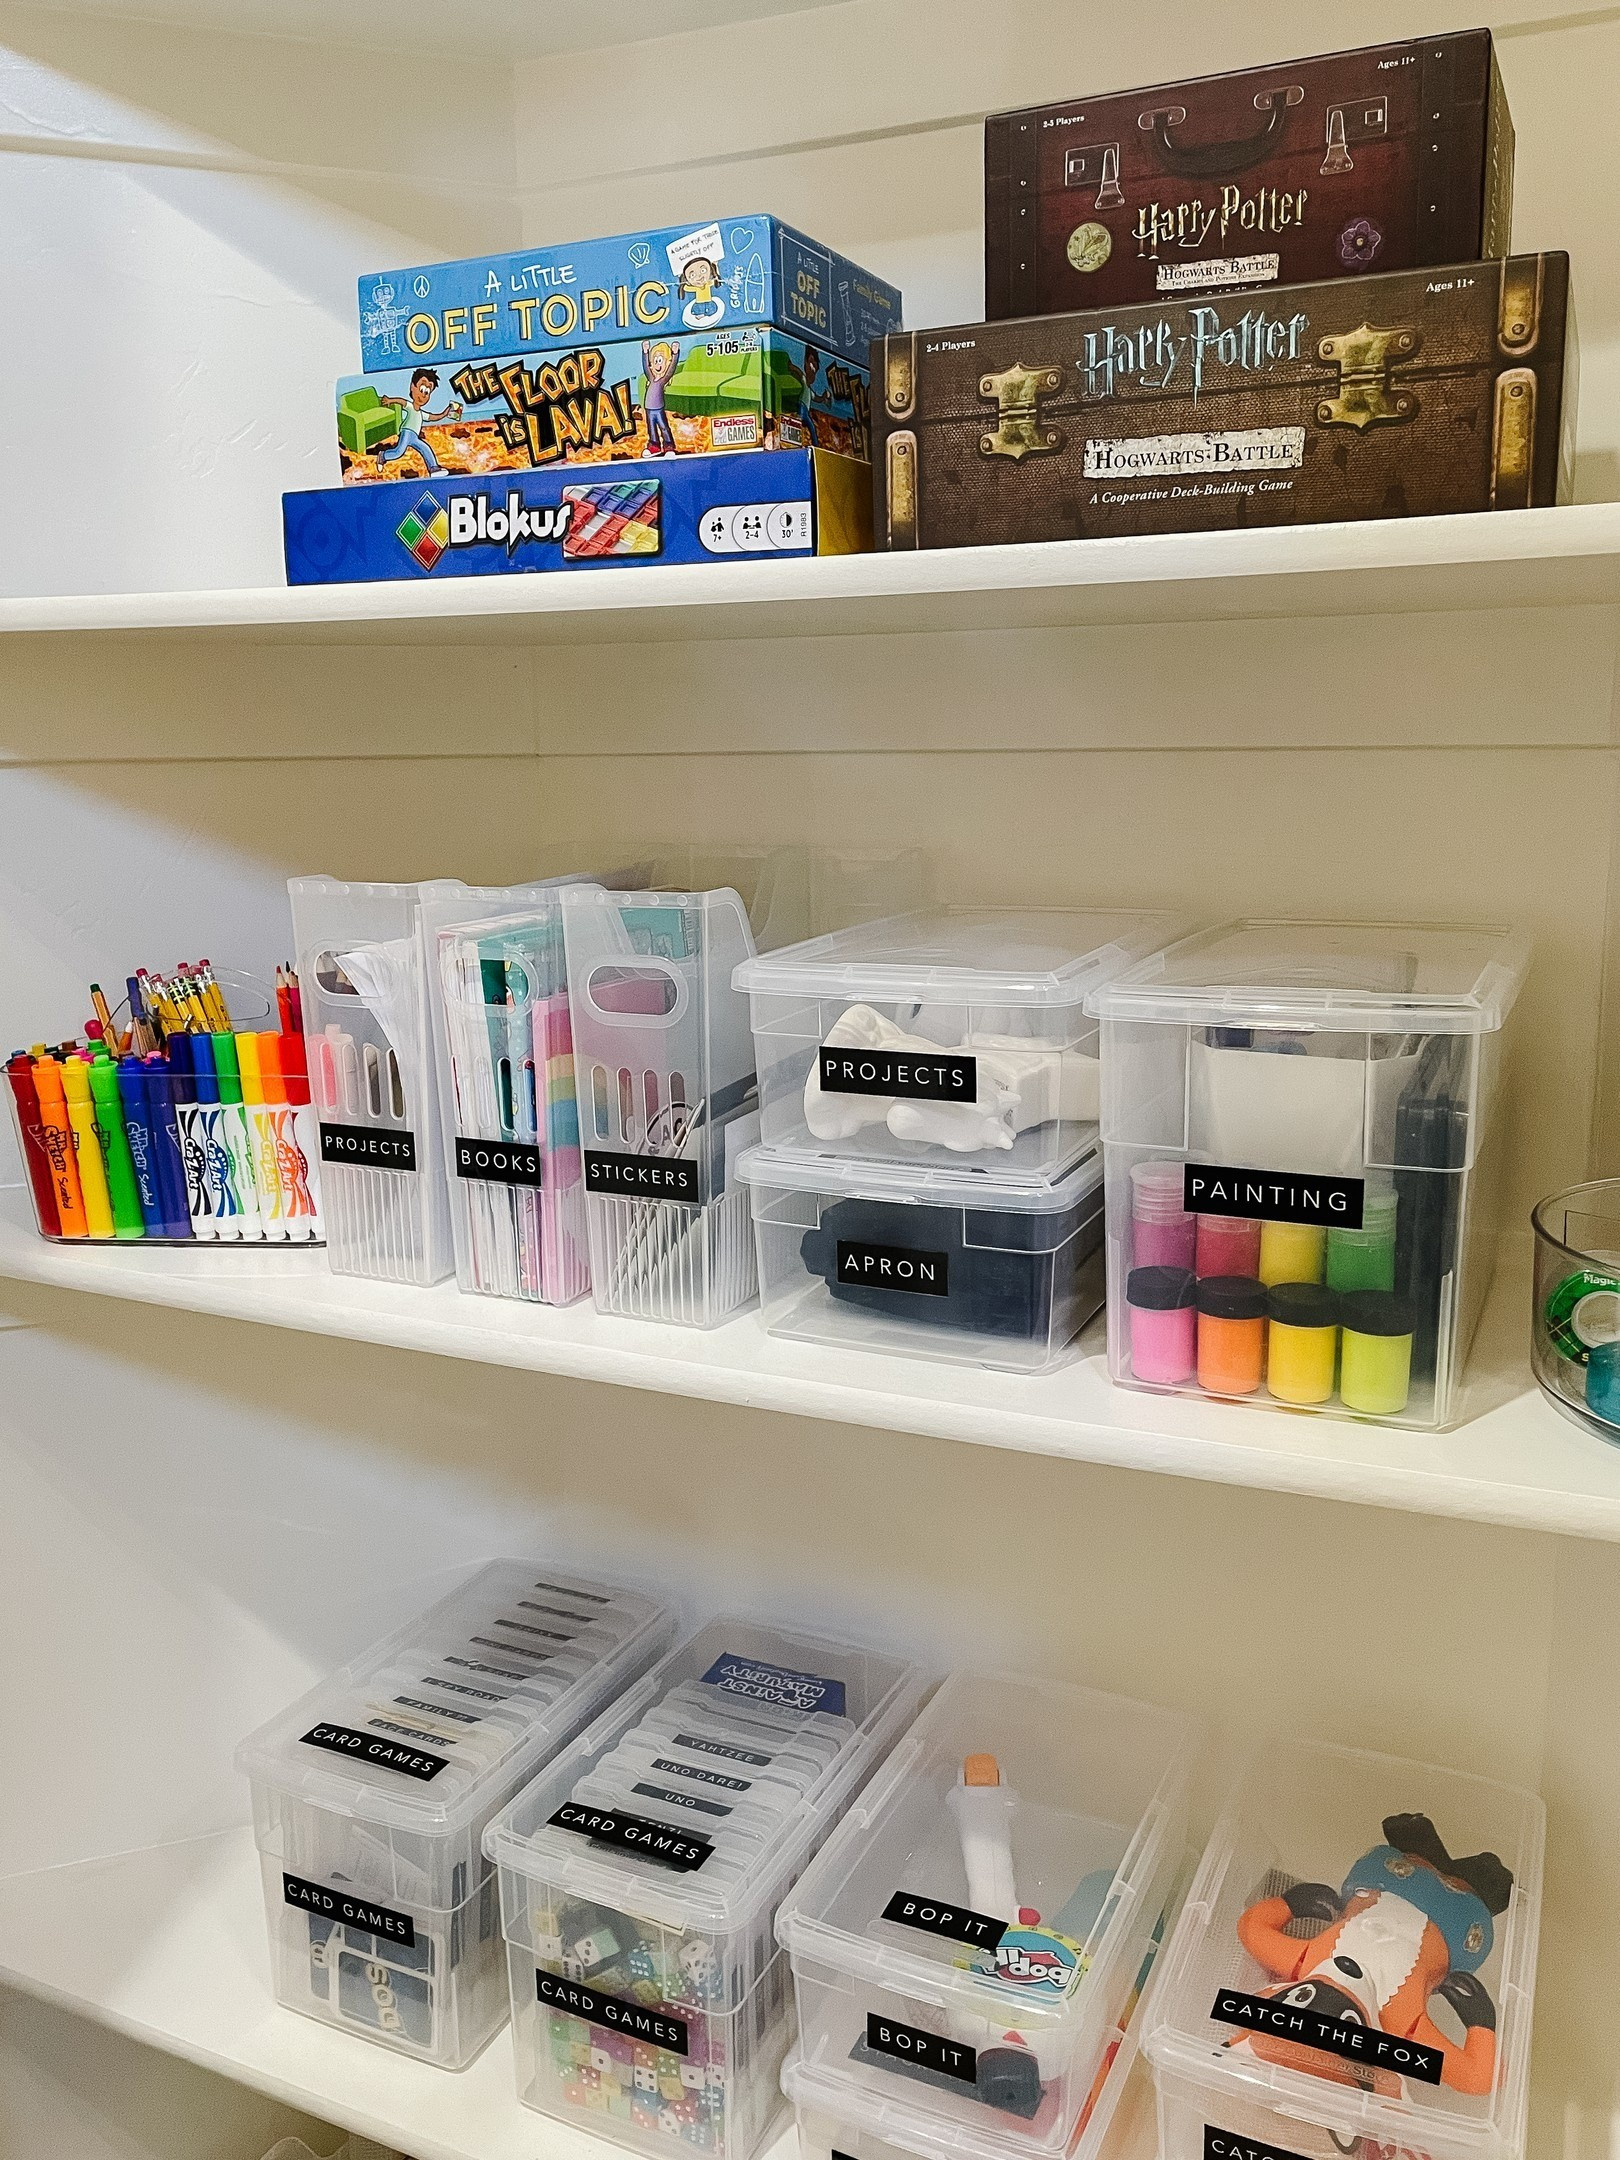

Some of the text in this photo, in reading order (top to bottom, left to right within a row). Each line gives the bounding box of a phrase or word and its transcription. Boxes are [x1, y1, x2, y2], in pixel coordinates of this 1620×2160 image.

[1377, 56, 1416, 70] Ages 11+
[1056, 115, 1085, 126] Players
[1131, 184, 1308, 260] Harry Potter
[484, 264, 577, 297] A LITTLE
[1163, 259, 1277, 280] HOGWARTS BATTLE
[797, 269, 820, 299] OFF
[1426, 278, 1475, 293] Ages 11+
[405, 280, 670, 354] OFF TOPIC
[790, 290, 827, 328] TOPIC
[707, 341, 739, 356] 5-105
[941, 340, 976, 351] Players
[1075, 306, 1311, 409] Harry Potter
[454, 350, 602, 415] THE FLOOR
[524, 384, 634, 462] LAVA!
[713, 416, 755, 428] Endless
[727, 424, 755, 442] GAMES
[1094, 442, 1294, 470] HOGWARTS BATTLE
[1089, 478, 1294, 506] A Cooperative Deck-Building Game
[449, 492, 572, 547] Blokus
[713, 533, 722, 542] 7+
[745, 530, 759, 539] 2-4
[826, 1060, 964, 1087] PROJECTS
[325, 1135, 411, 1158] PROJECTS
[460, 1148, 537, 1173] BOOKS
[590, 1162, 688, 1187] STICKERS
[57, 1176, 74, 1210] Scented
[138, 1173, 155, 1206] Scented
[1191, 1178, 1348, 1212] PAINTING
[845, 1254, 935, 1281] APRON
[1583, 1273, 1617, 1286] Magic
[720, 1664, 825, 1698] MATURITY
[406, 1700, 454, 1716] FAMILY
[312, 1727, 436, 1774] CARD GAMES
[408, 1731, 450, 1747] CARDS
[690, 1740, 754, 1762] YAHTZEE
[661, 1762, 744, 1788] UNO DARE!
[665, 1793, 696, 1807] UNO
[560, 1809, 615, 1831] CARD
[624, 1827, 700, 1859] GAMES
[287, 1883, 406, 1936] CARD GAMES
[903, 1903, 988, 1936] BOP IT
[541, 1980, 679, 2043] CARD GAMES
[880, 2028, 961, 2066] BOP IT
[1222, 2000, 1429, 2069] CATCH THE FOX
